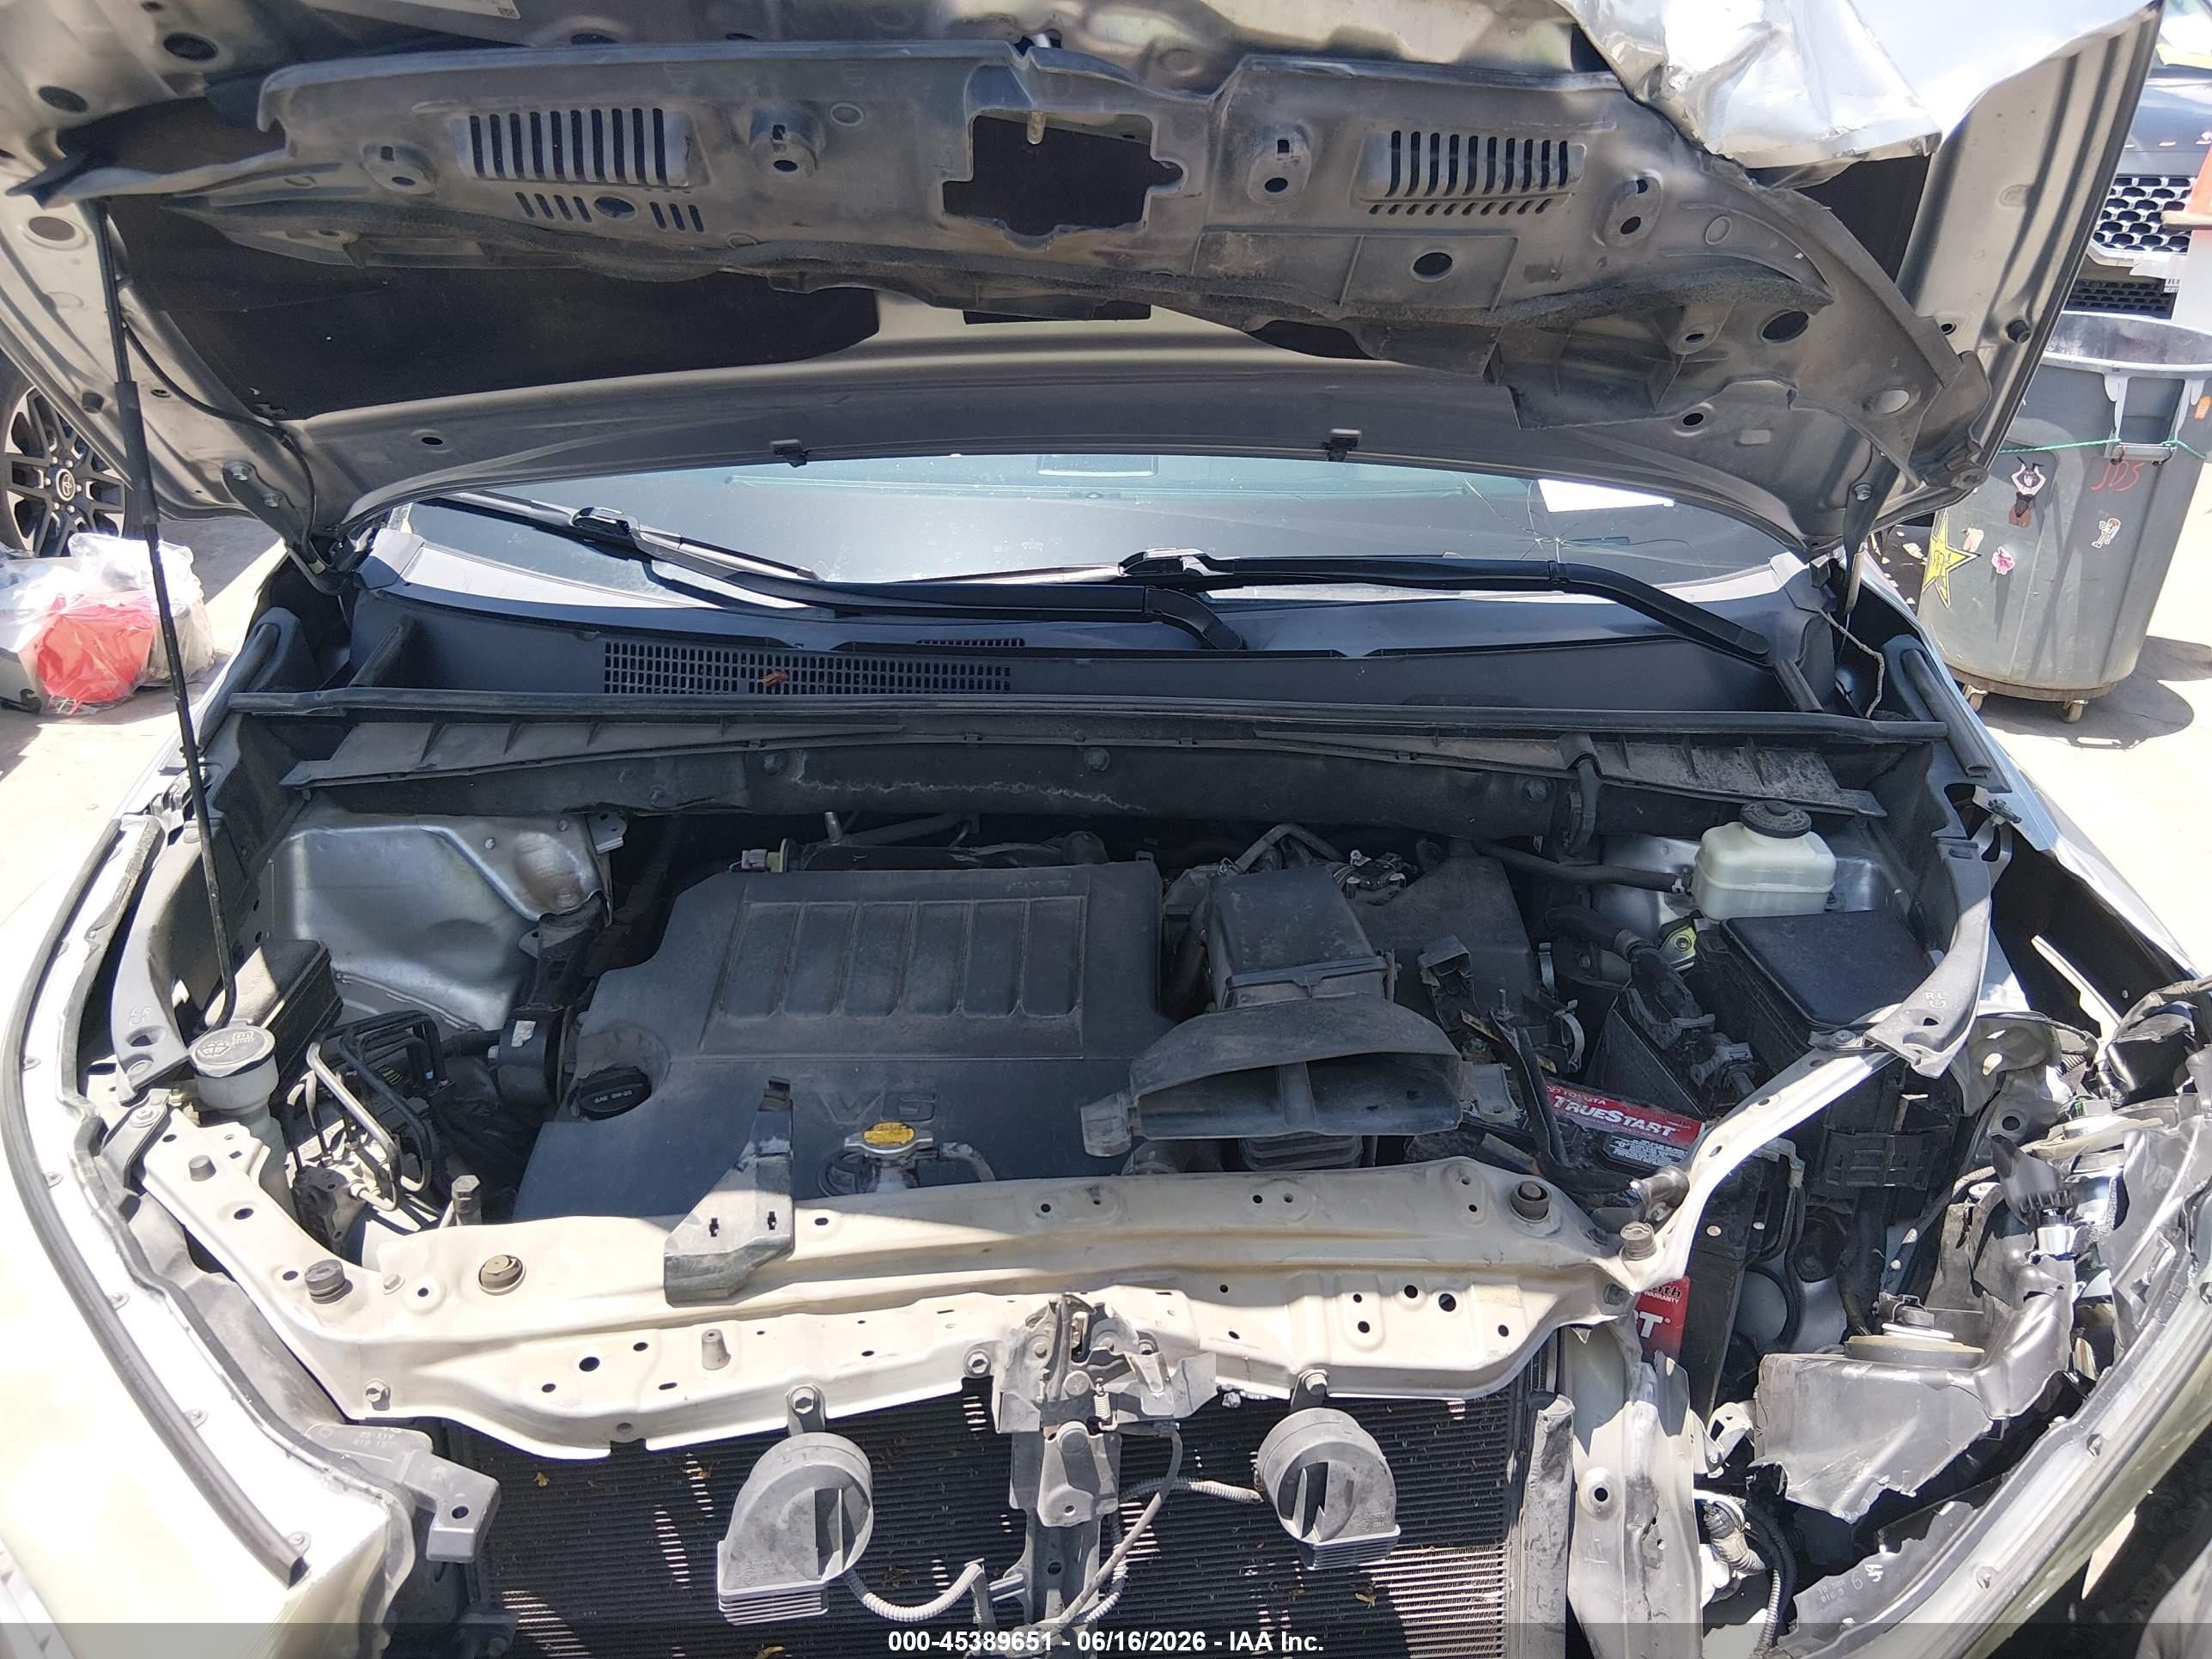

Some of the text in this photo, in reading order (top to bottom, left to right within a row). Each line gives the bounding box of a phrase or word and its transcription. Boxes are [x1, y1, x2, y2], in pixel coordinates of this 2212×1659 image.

[1562, 1089, 1607, 1106] TOYOTA
[1553, 1095, 1677, 1137] TRUESTART
[1644, 1291, 1680, 1304] WARRANTY
